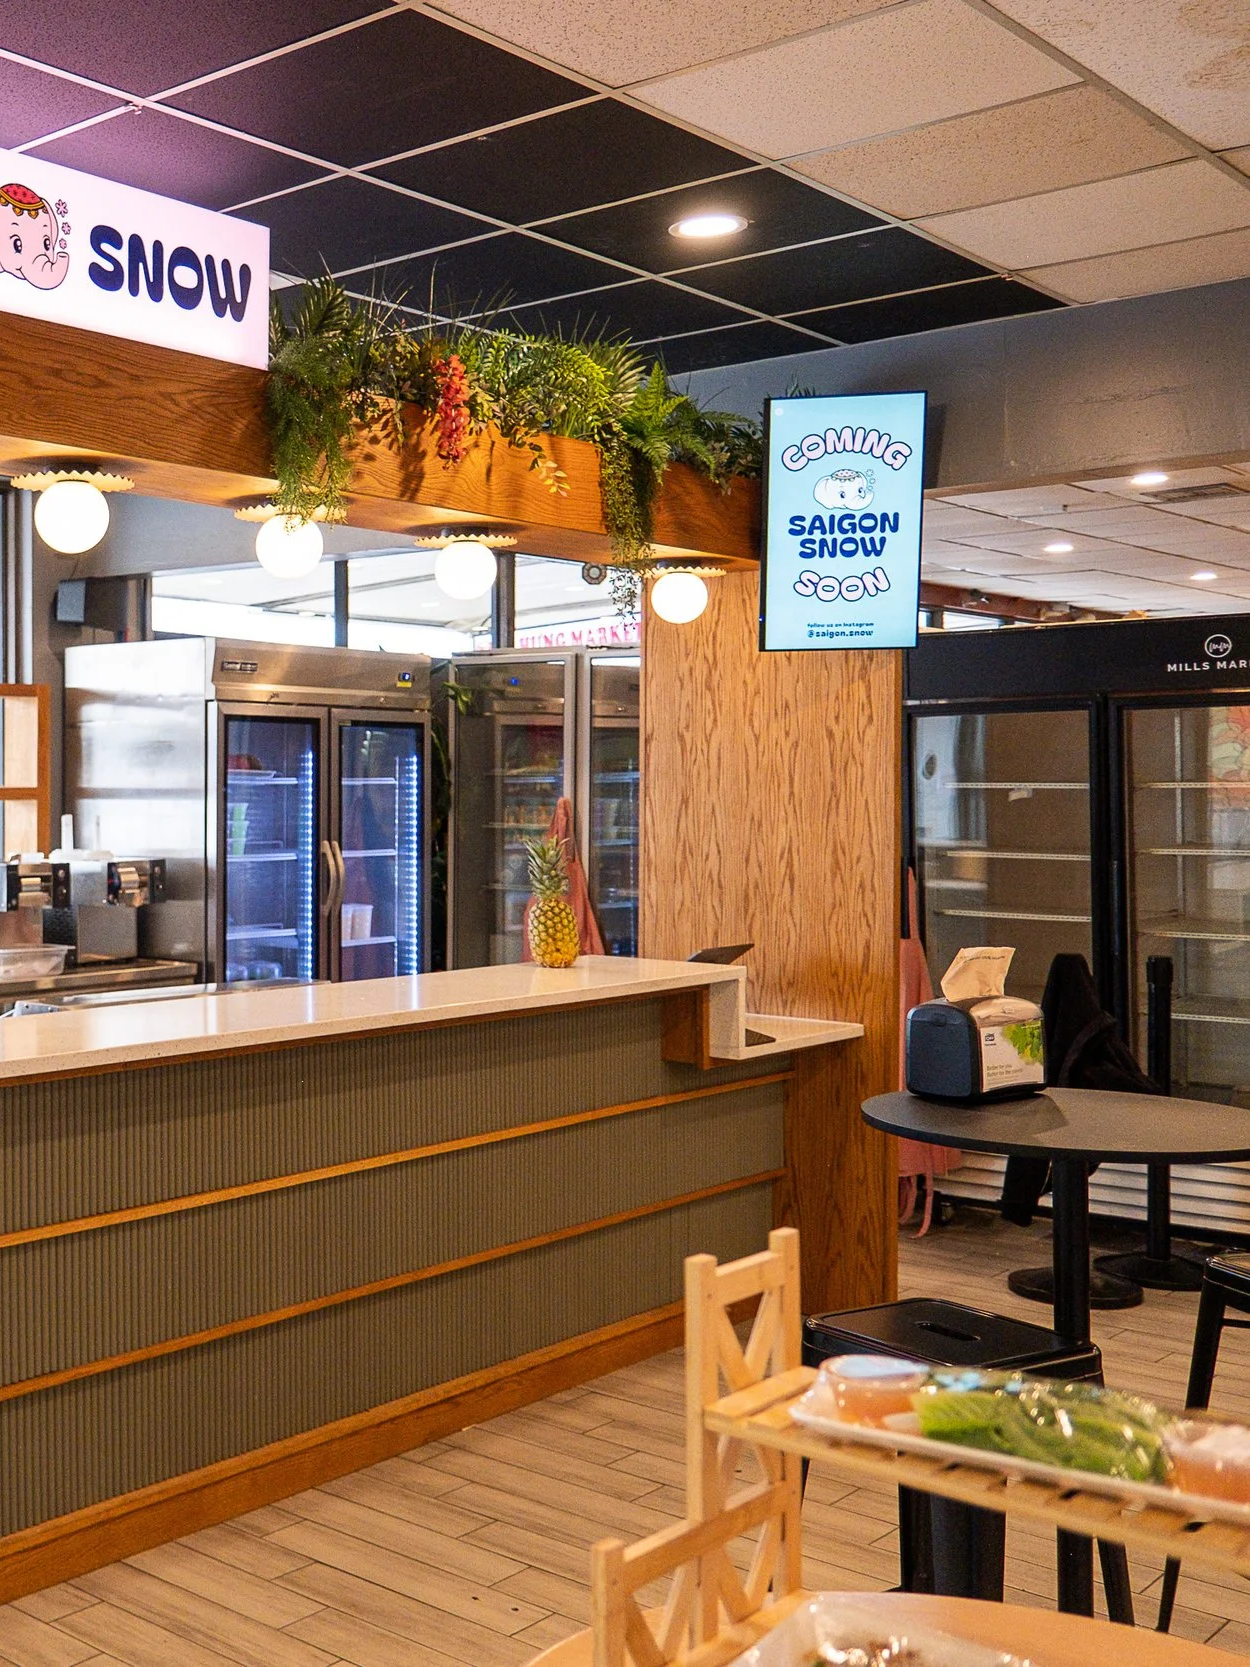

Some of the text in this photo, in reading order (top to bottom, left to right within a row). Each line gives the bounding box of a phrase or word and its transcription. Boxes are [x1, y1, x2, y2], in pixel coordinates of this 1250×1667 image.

[88, 224, 251, 322] SNOW
[781, 426, 912, 472] COMING
[788, 512, 900, 536] SAIGON
[798, 536, 887, 559] SNOW
[793, 567, 891, 602] SOON
[807, 629, 874, 639] @saigon.snow
[1167, 659, 1250, 672] MILLS MAR
